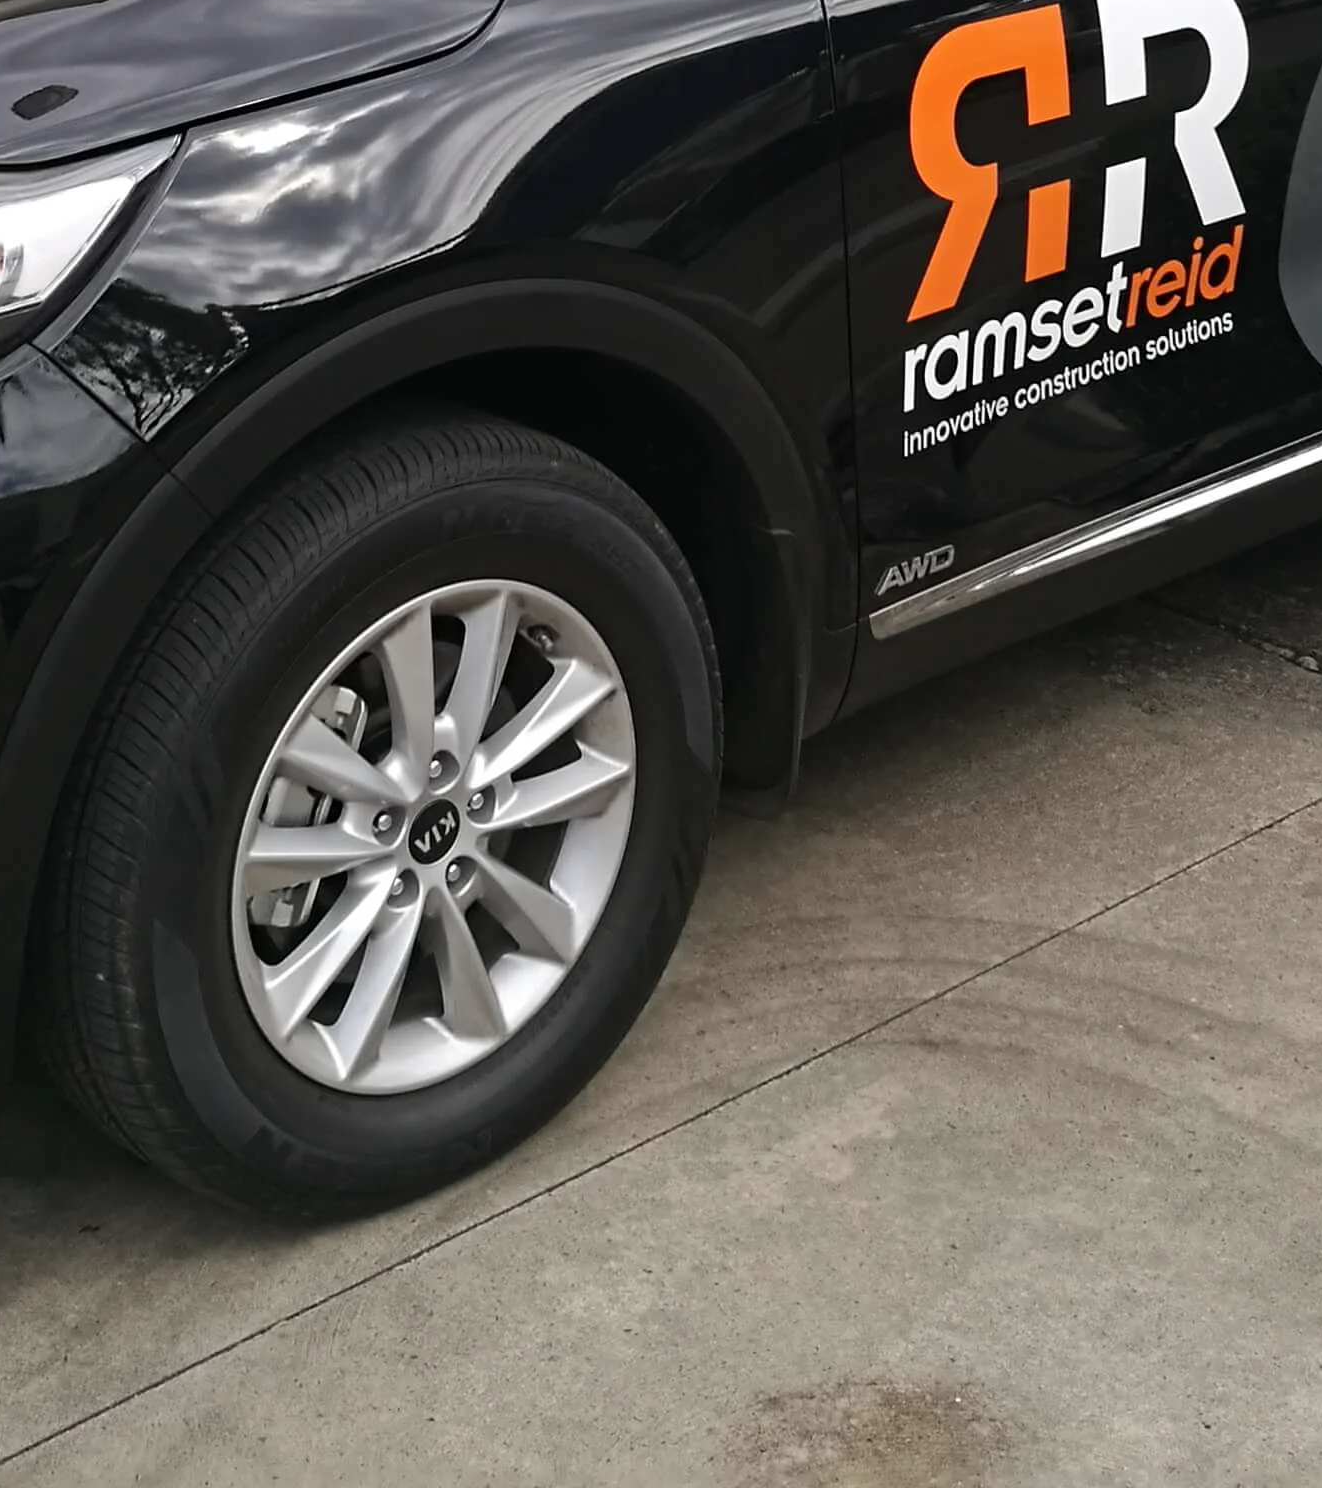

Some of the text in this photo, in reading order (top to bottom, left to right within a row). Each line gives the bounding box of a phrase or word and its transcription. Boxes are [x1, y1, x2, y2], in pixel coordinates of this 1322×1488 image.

[903, 312, 1234, 457] innovative construction solutions
[874, 544, 955, 597] AWD
[413, 810, 457, 853] KIA
